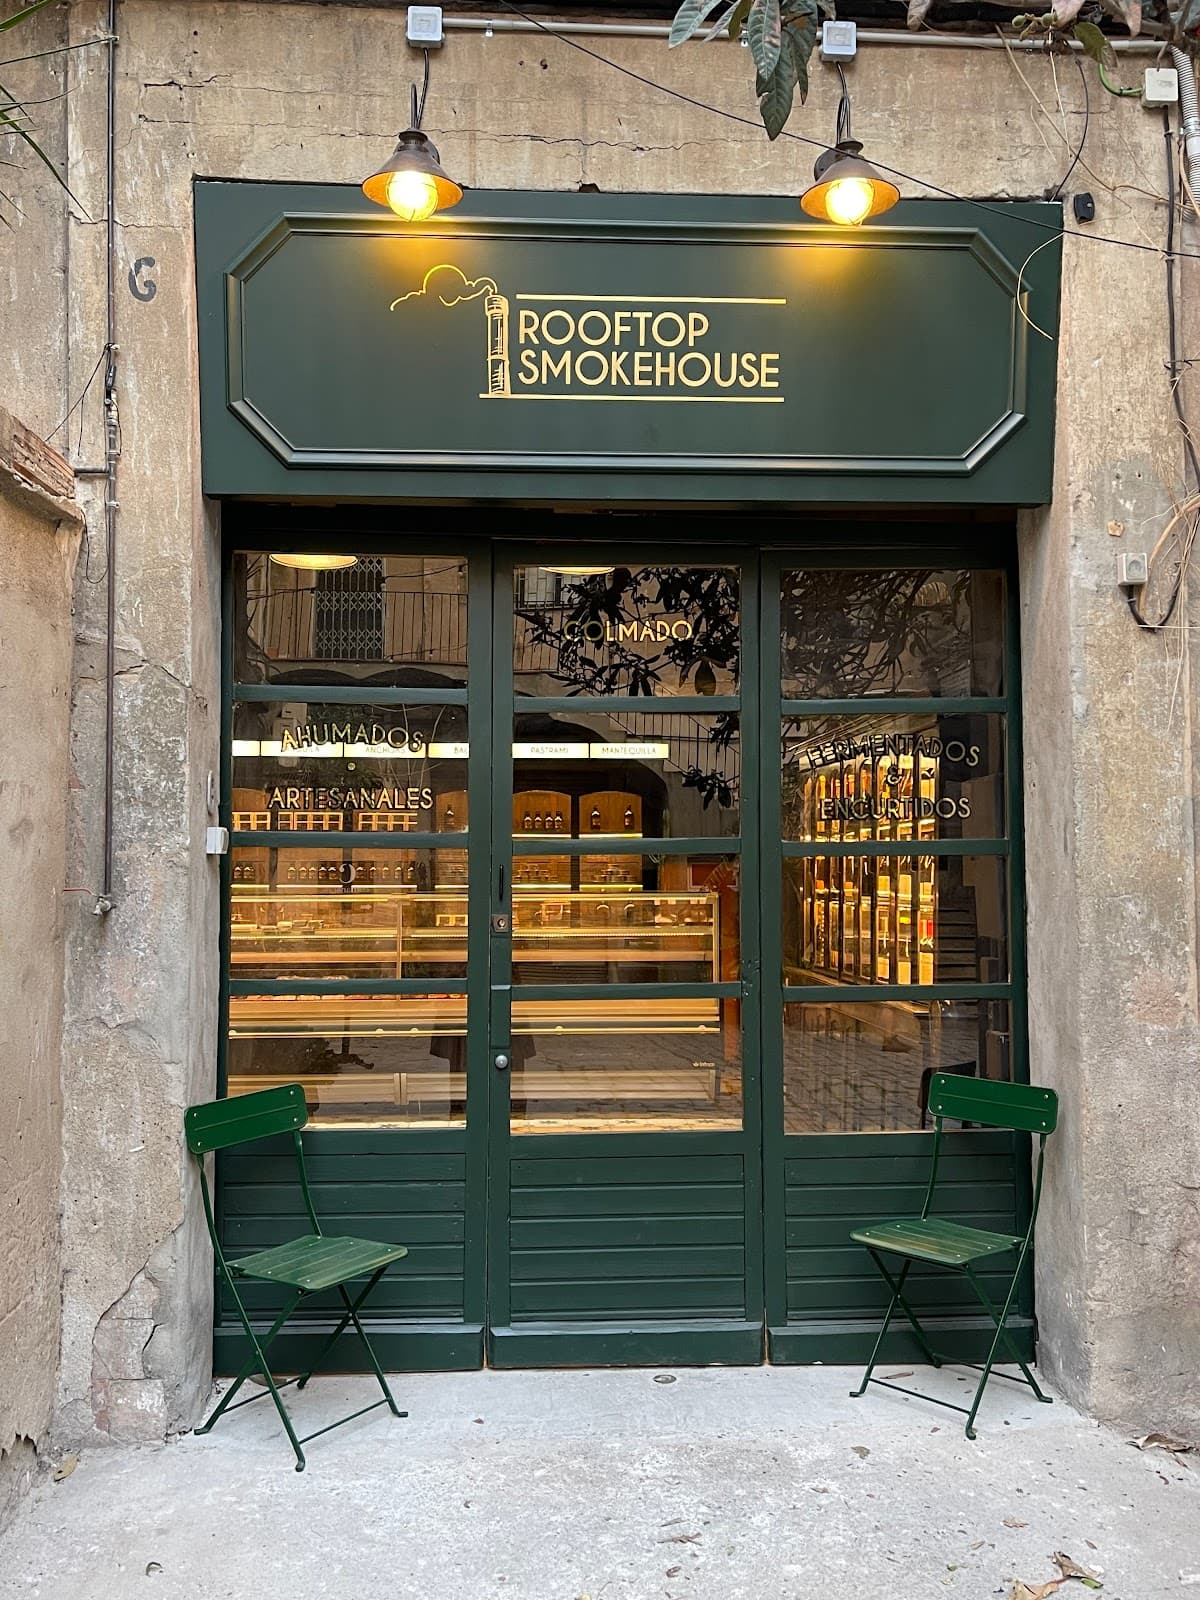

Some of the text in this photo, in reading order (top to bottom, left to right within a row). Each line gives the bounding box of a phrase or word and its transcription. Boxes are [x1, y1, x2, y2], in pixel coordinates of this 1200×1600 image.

[519, 309, 710, 347] ROOFTOP
[518, 350, 780, 388] SMOKEHOUSE
[563, 619, 693, 642] COLMADO
[281, 722, 423, 752] AHUMADOS
[806, 733, 980, 767] FERMENTADOS
[886, 764, 903, 785] &
[267, 787, 433, 810] ARTESANALES
[819, 797, 971, 820] ENCURTIDOS
